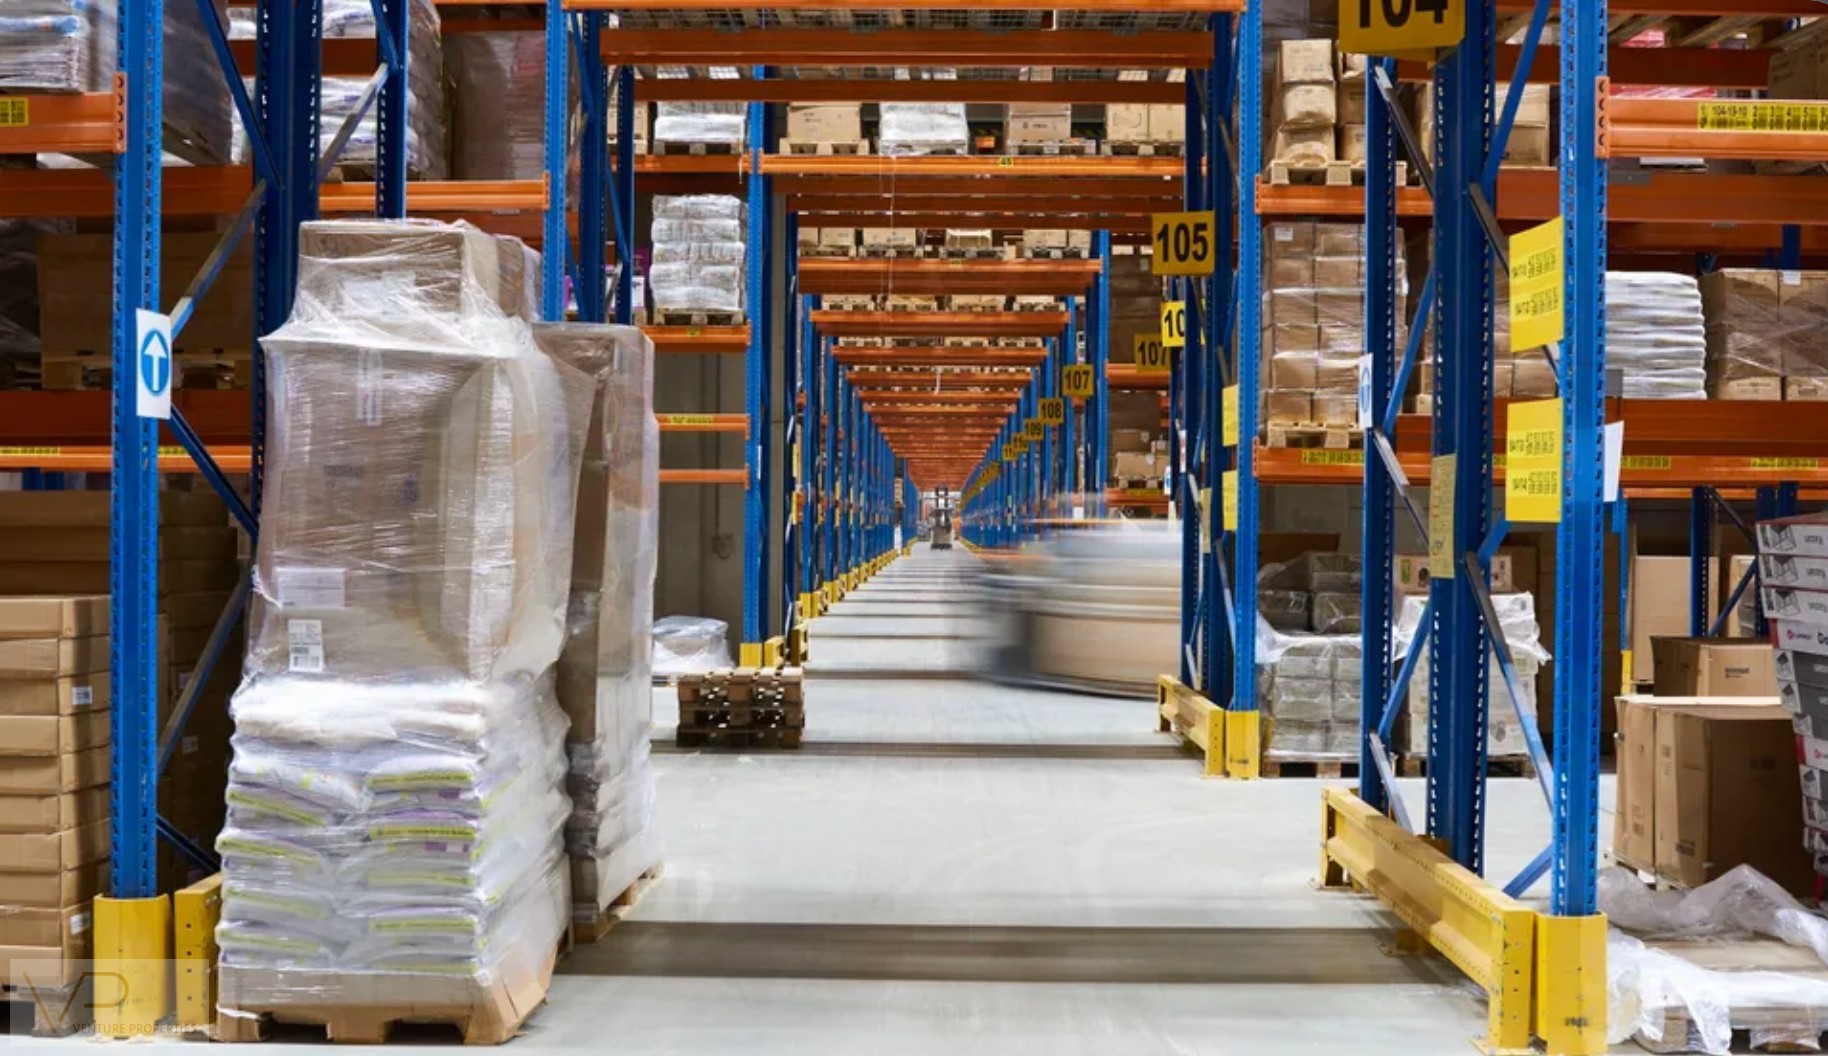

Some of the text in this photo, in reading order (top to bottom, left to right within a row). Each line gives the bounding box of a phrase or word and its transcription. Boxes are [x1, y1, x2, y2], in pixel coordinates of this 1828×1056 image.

[1157, 222, 1208, 262] 105
[1164, 309, 1185, 337] 10
[1065, 370, 1090, 390] 107
[1041, 403, 1062, 418] 108
